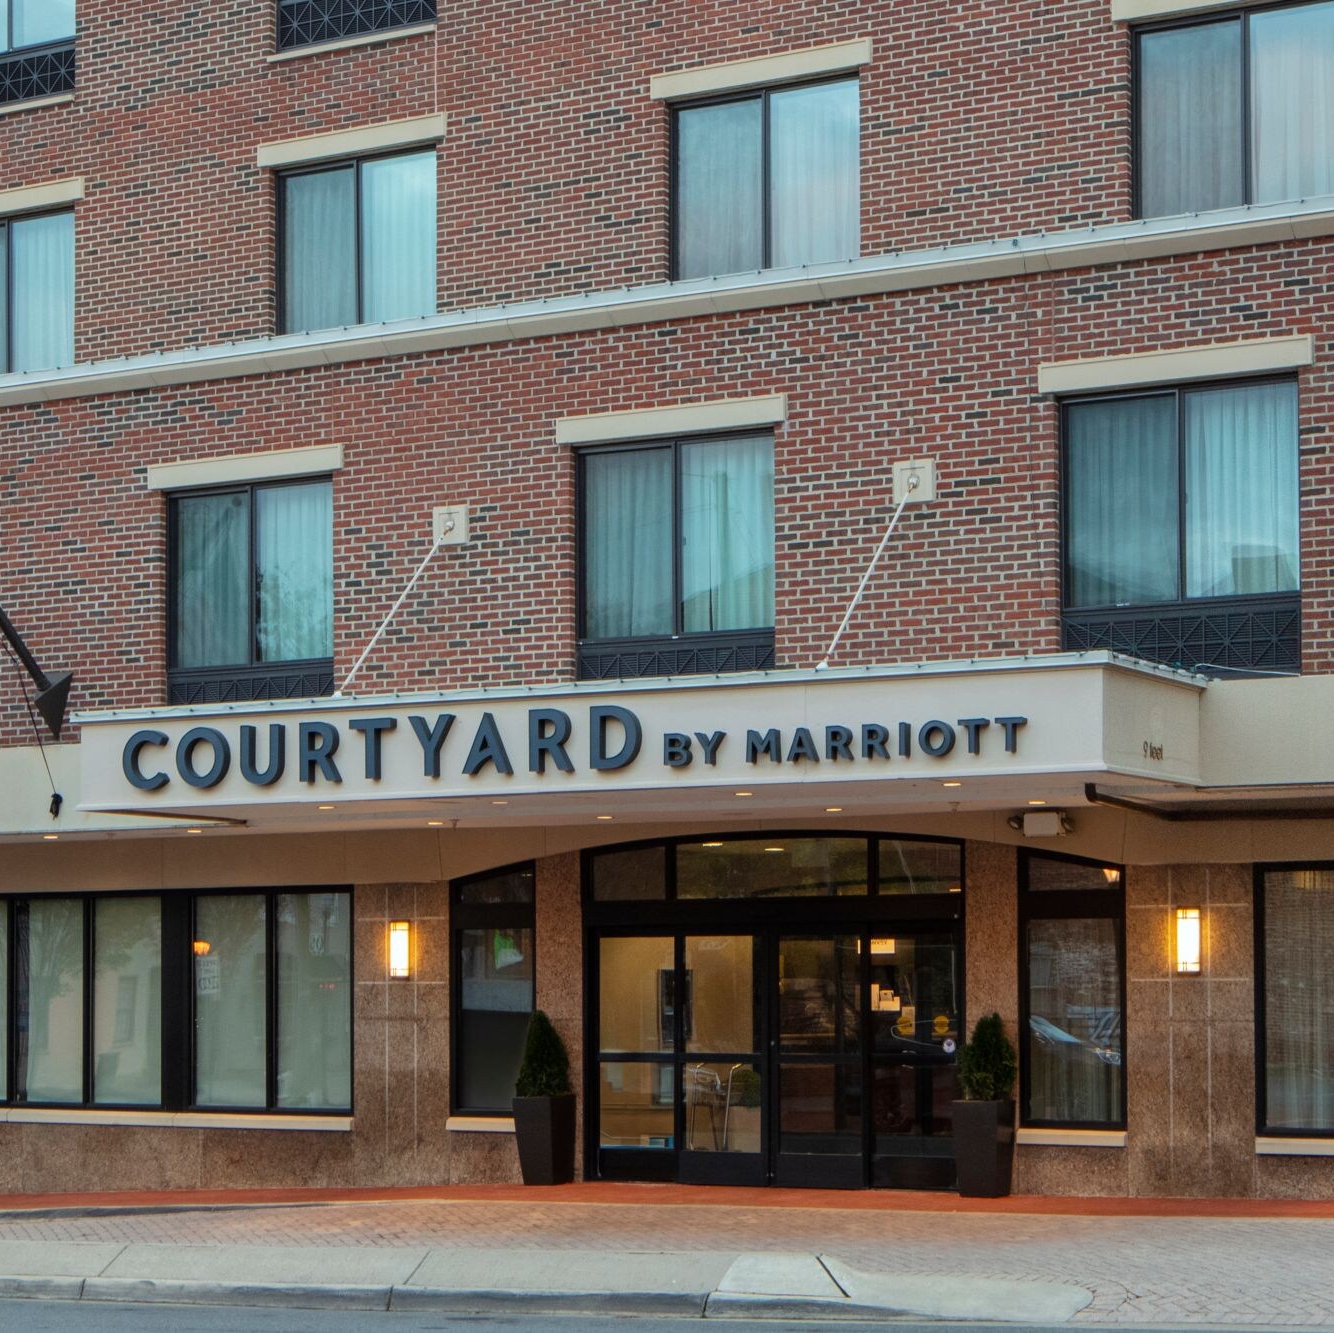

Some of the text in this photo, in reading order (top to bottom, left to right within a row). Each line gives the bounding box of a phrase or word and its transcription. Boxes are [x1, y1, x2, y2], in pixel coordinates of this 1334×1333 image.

[122, 704, 1029, 796] COURTYARD BY MARRIOTT
